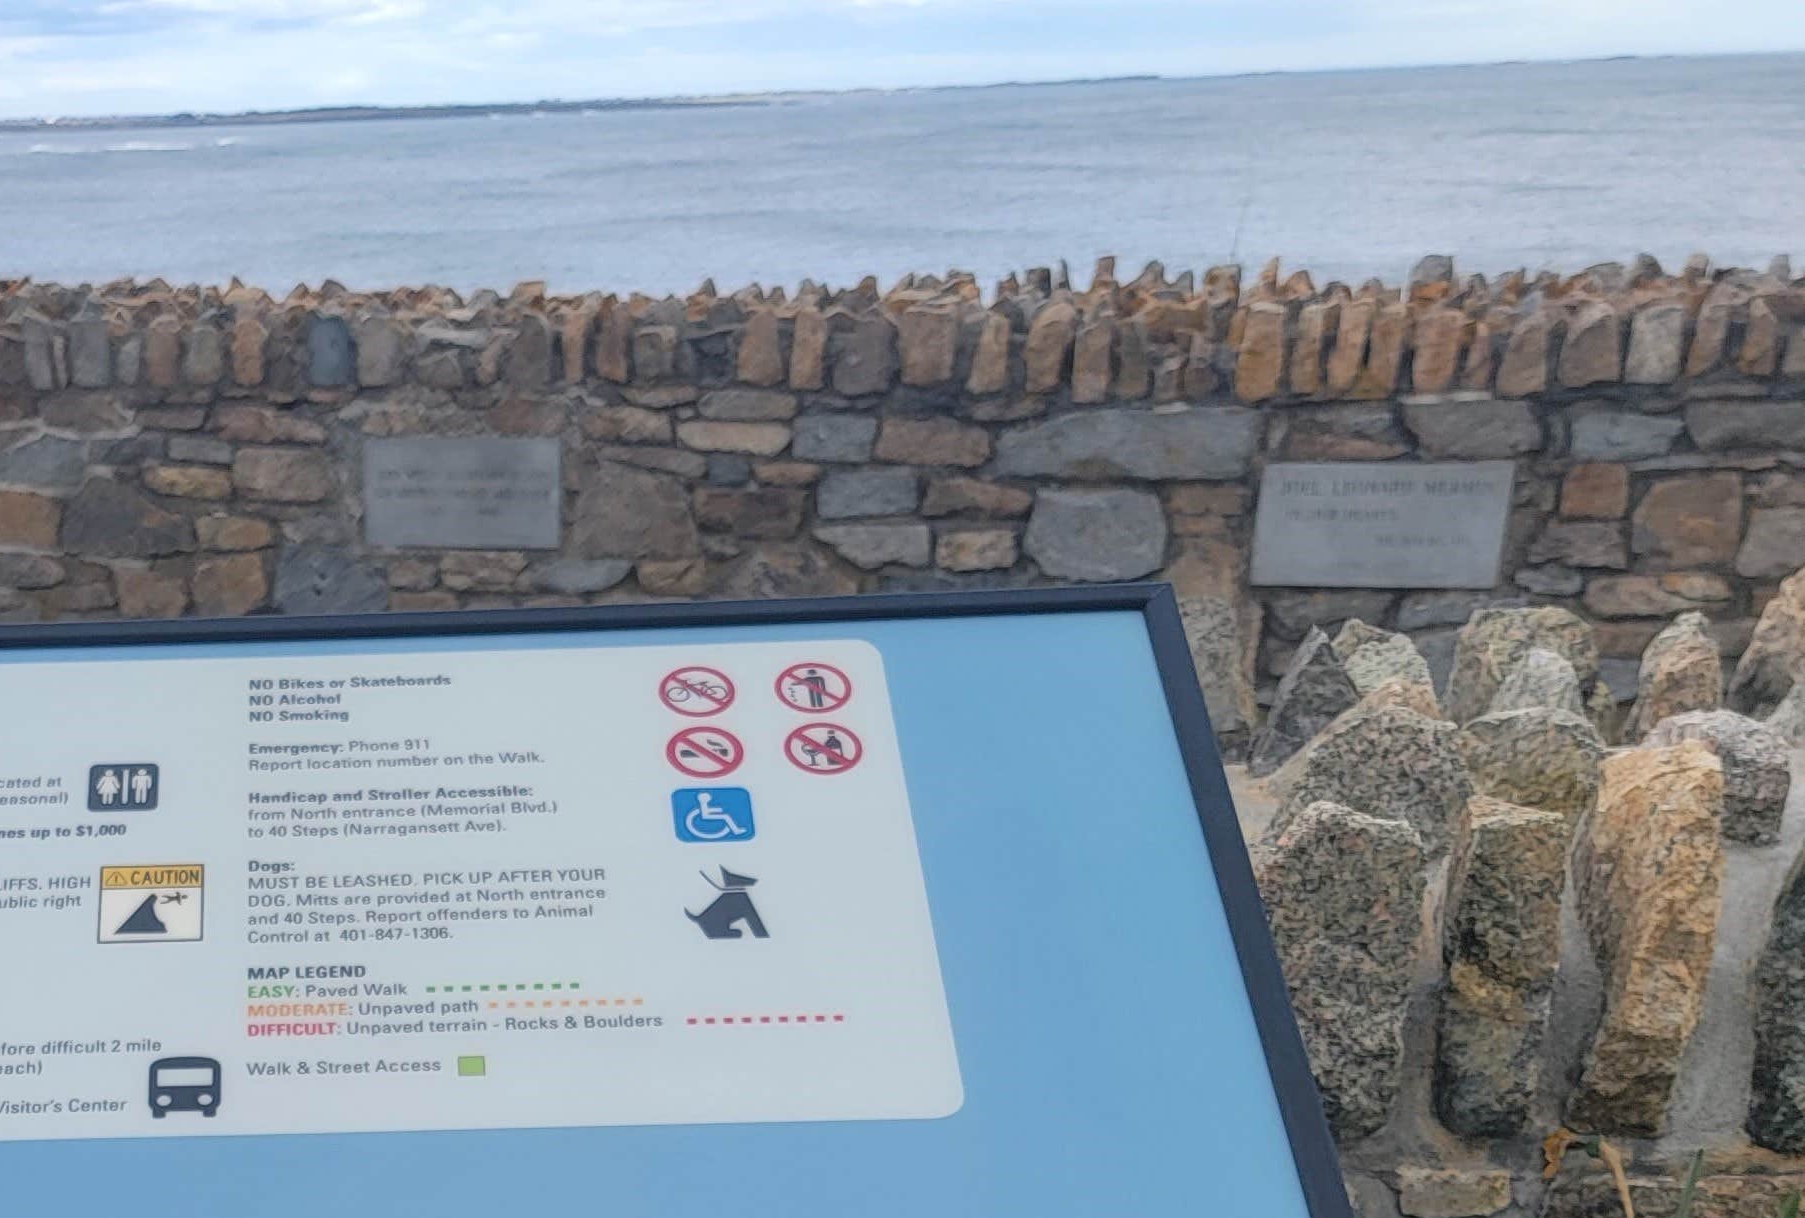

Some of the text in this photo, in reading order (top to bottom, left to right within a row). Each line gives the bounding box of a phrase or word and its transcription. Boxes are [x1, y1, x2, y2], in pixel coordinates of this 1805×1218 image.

[248, 692, 342, 707] NO Alcohol
[248, 709, 350, 723] NO Smoking
[248, 738, 430, 756] Emergency: Phone 911
[29, 828, 52, 841] up
[55, 827, 72, 838] to
[75, 823, 127, 838] $1,000
[248, 859, 296, 875] Dogs:
[130, 869, 200, 886] CAUTION
[247, 964, 367, 981] MAP LEGEND
[247, 982, 408, 999] EASY: Paved Walk
[248, 999, 480, 1017] MODERATE: Unpaved path
[247, 1014, 664, 1037] DIFFICULT: Unpaved terrain Rocks & Boulders
[245, 1059, 441, 1077] Walk & Street Access
